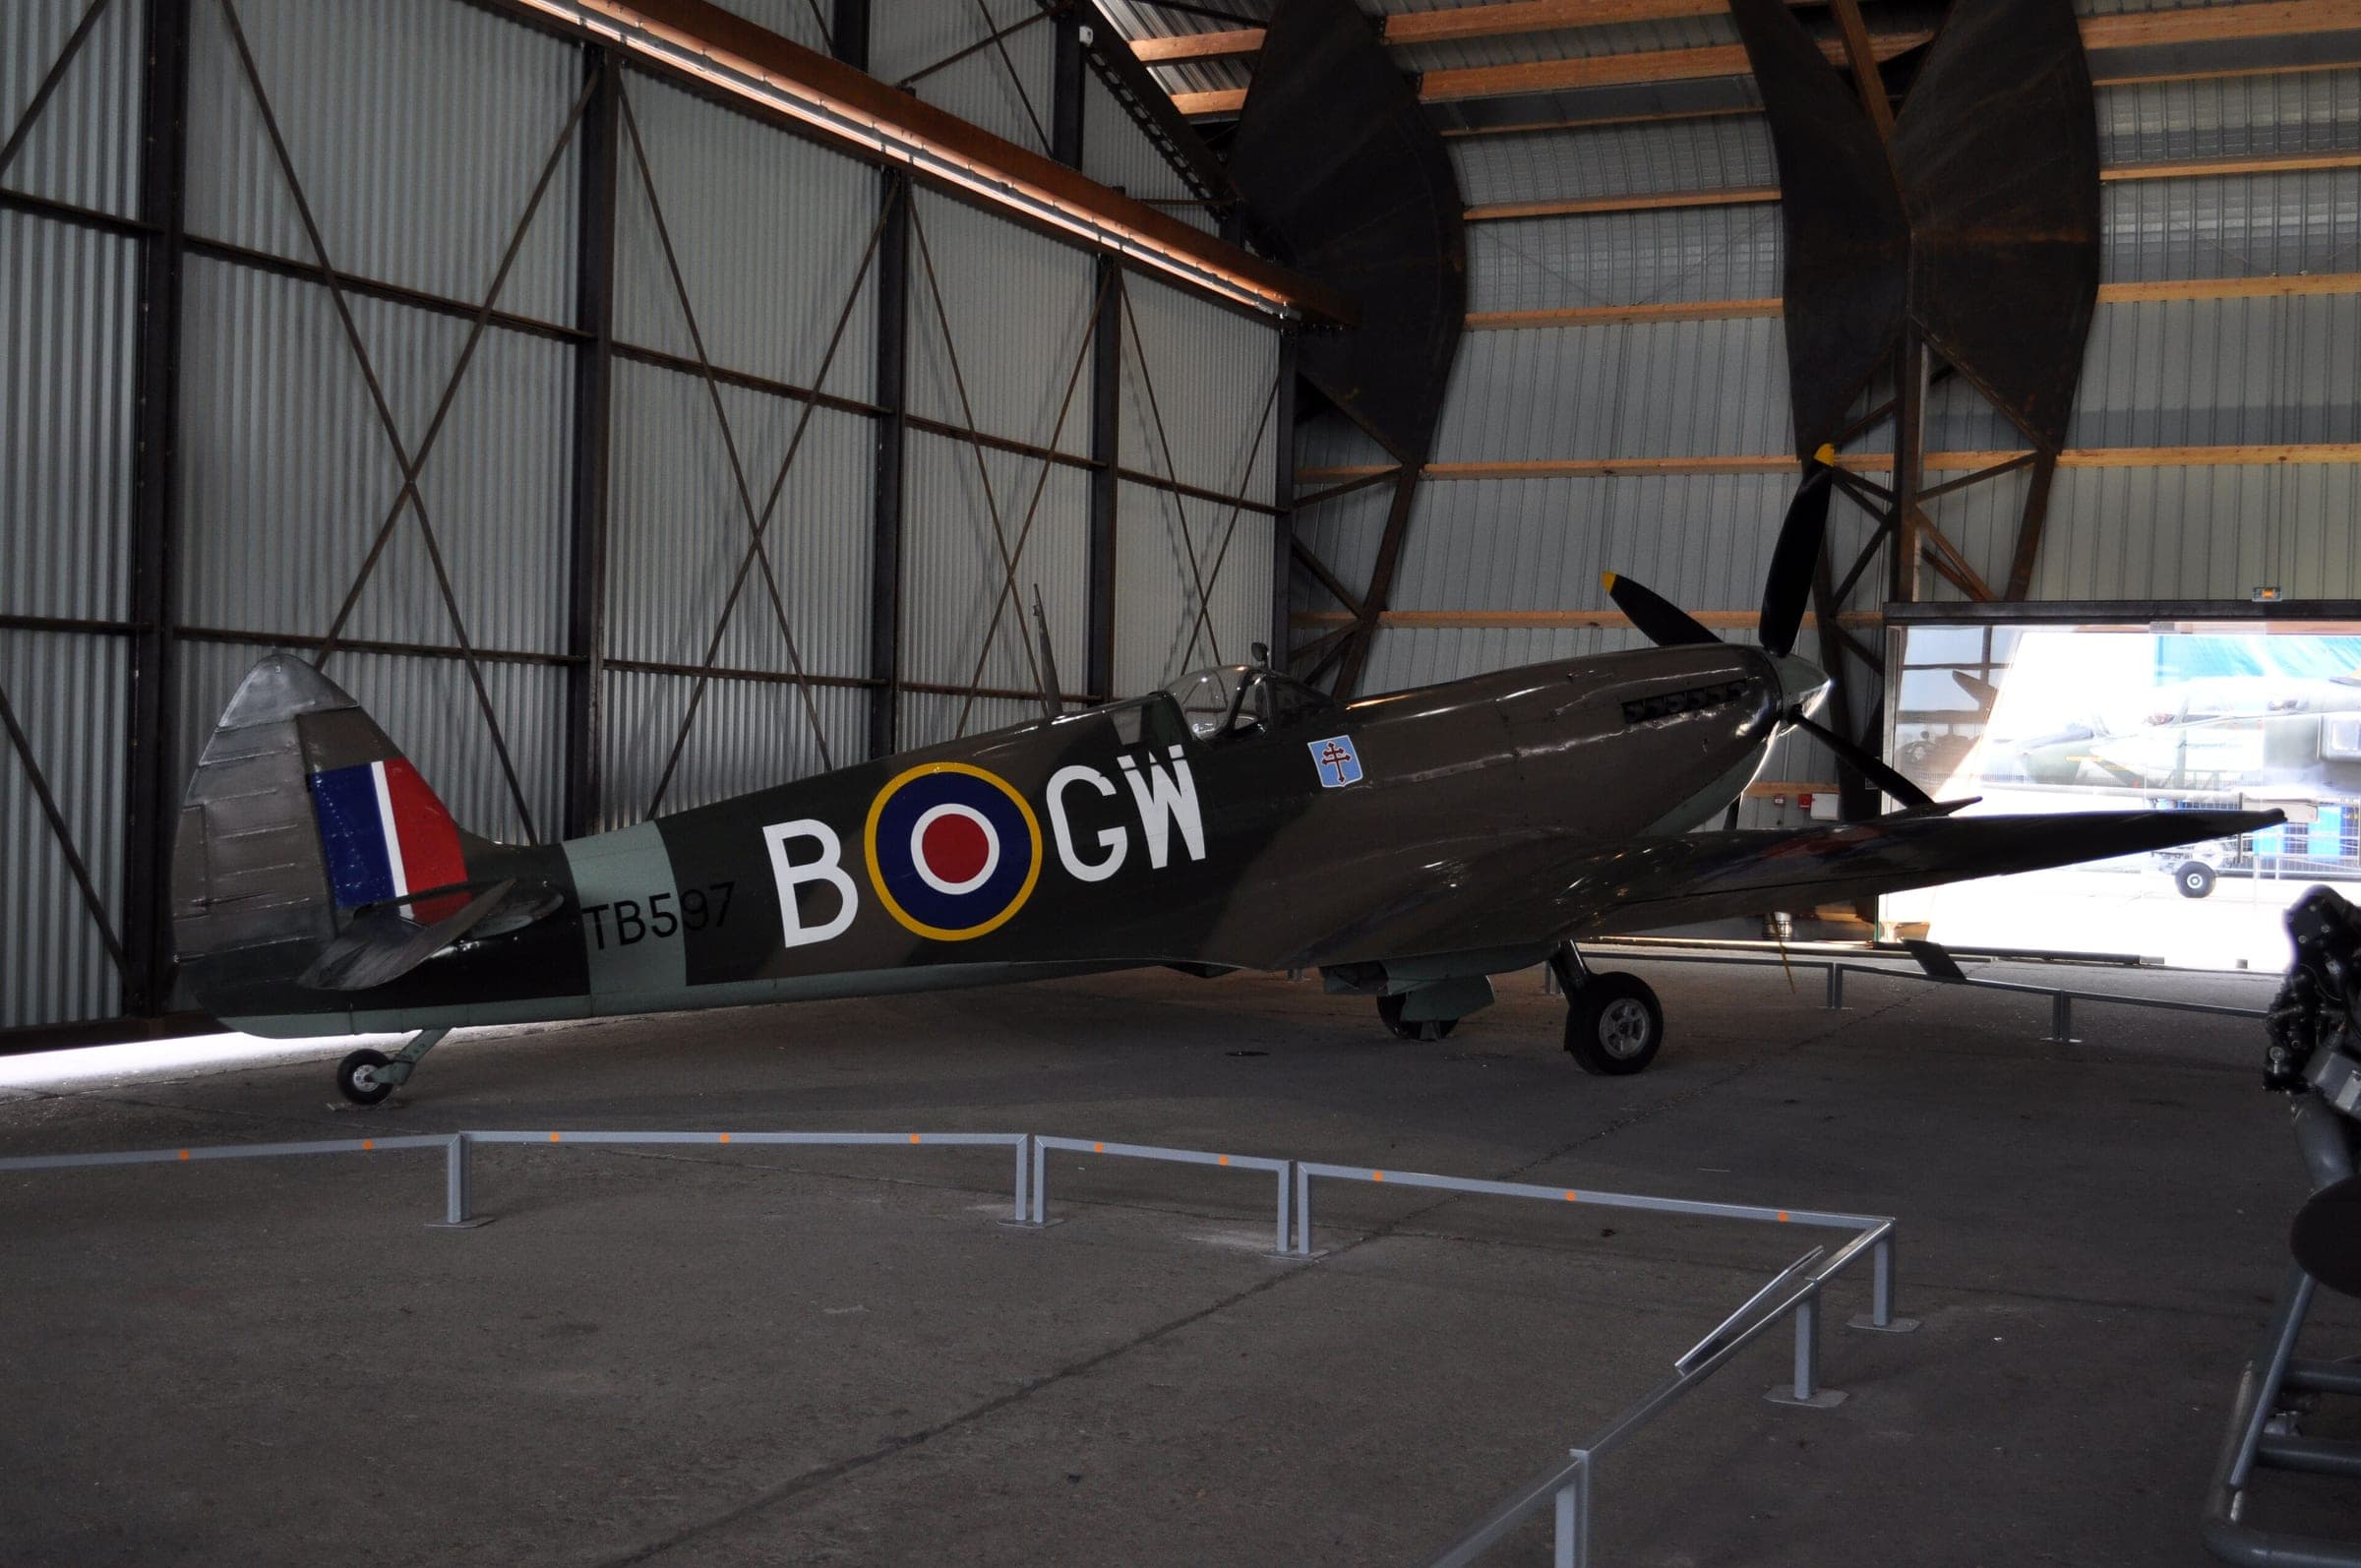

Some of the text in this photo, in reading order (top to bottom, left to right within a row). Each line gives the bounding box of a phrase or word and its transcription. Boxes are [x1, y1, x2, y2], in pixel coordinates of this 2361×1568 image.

[762, 744, 1206, 948] B GW
[580, 881, 735, 949] TB597
